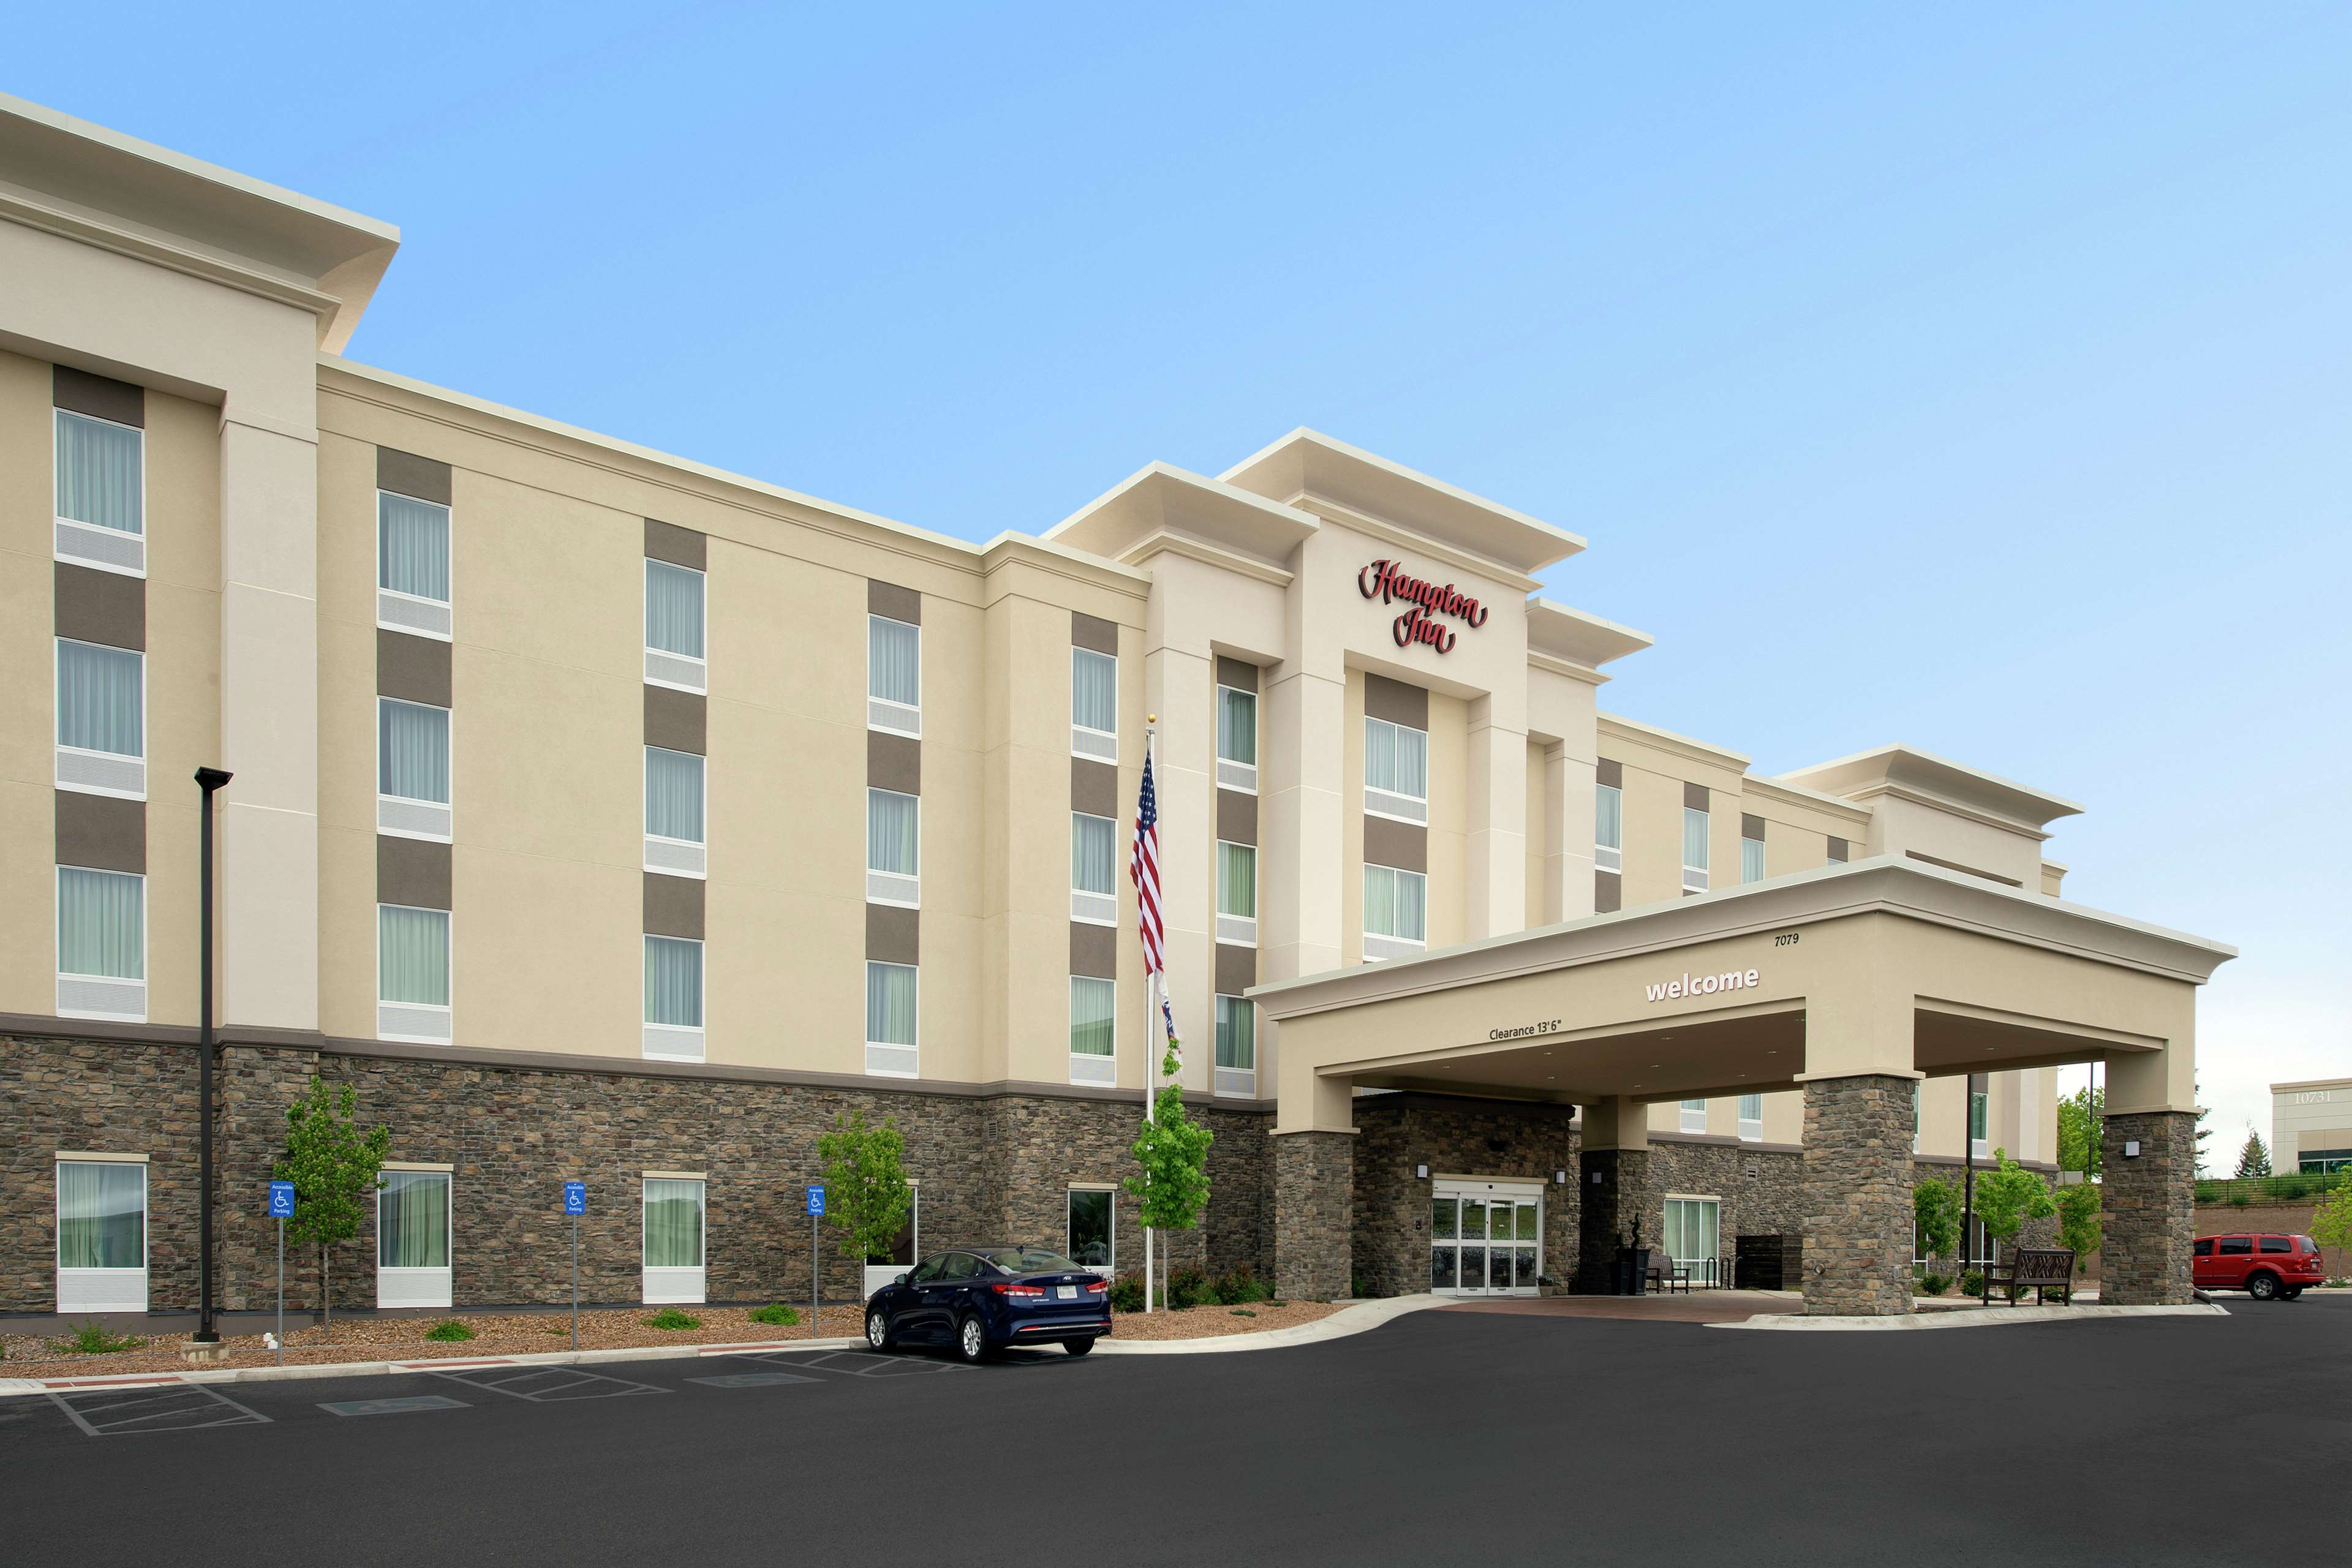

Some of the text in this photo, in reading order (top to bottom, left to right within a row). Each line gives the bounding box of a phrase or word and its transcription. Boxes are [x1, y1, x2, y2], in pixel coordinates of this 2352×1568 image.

[1358, 559, 1488, 628] Hampton
[1393, 607, 1456, 654] Inn
[1775, 933, 1800, 947] 7079
[1646, 968, 1760, 1002] welcome
[1490, 1026, 1534, 1040] Clearance
[2295, 1091, 2331, 1104] 10731
